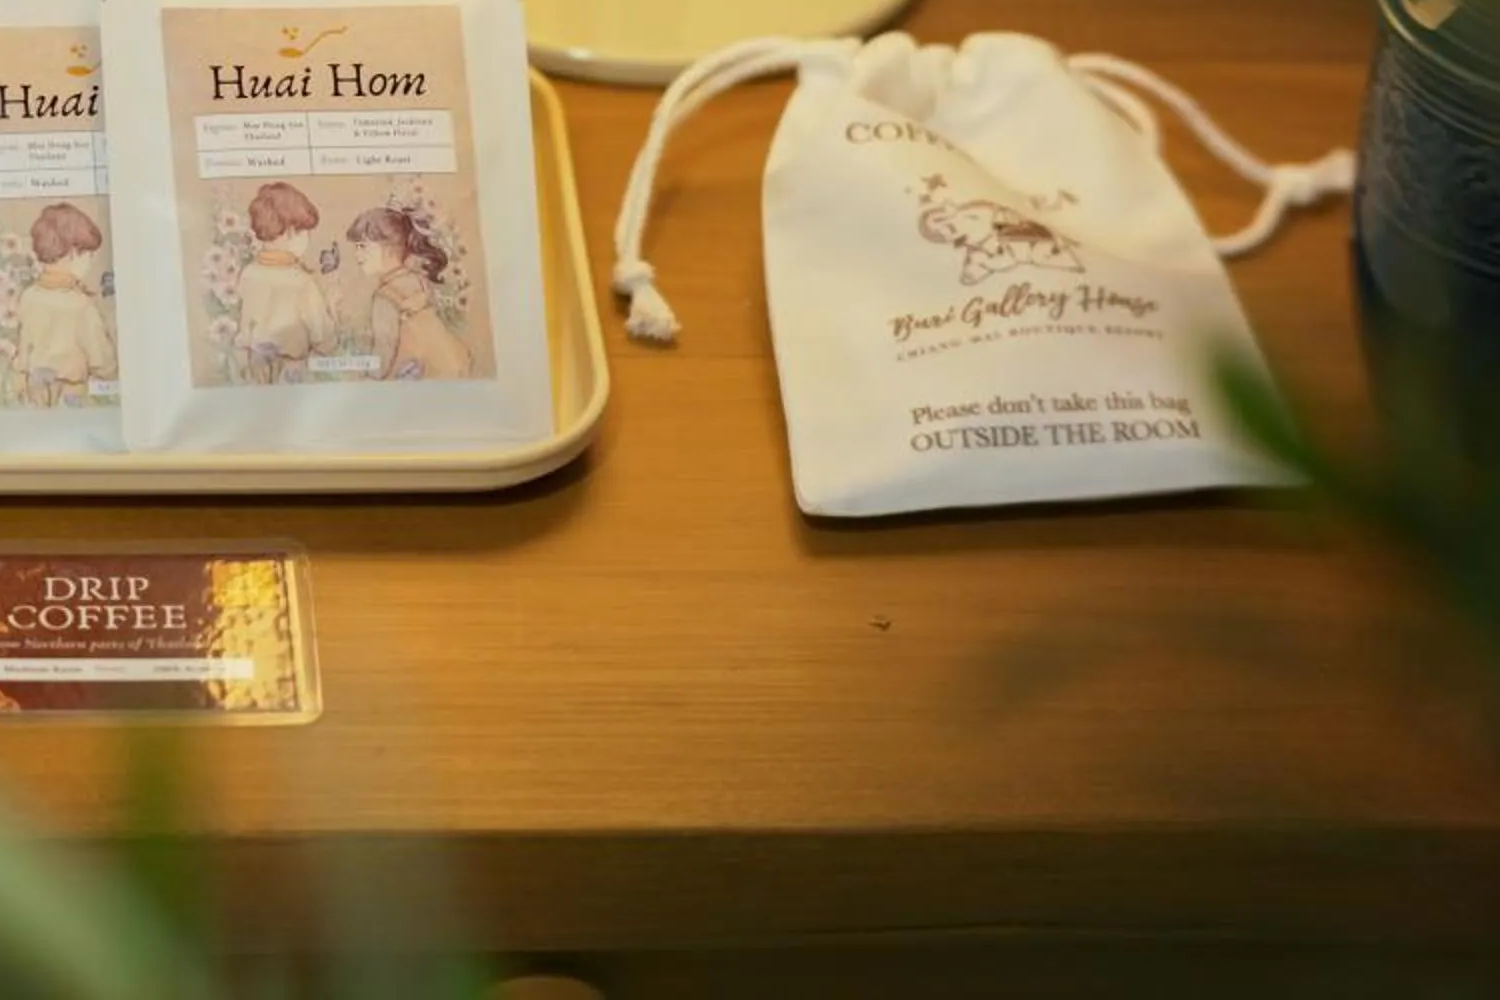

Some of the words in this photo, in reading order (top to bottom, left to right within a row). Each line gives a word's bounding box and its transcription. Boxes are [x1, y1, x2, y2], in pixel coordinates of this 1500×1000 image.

[208, 64, 313, 100] Huai
[327, 62, 428, 99] Hom
[960, 282, 1069, 328] Gallery
[1075, 284, 1160, 319] House
[910, 398, 982, 425] Please
[986, 394, 1047, 416] don't
[1051, 392, 1099, 413] take
[1104, 390, 1145, 411] this
[1149, 389, 1193, 415] bag
[909, 424, 1039, 451] OUTSIDE
[1044, 422, 1107, 447] THE
[1110, 418, 1202, 444] ROOM
[43, 576, 151, 602] DRIP
[7, 604, 189, 631] COFFEE
[24, 636, 87, 650] Northern
